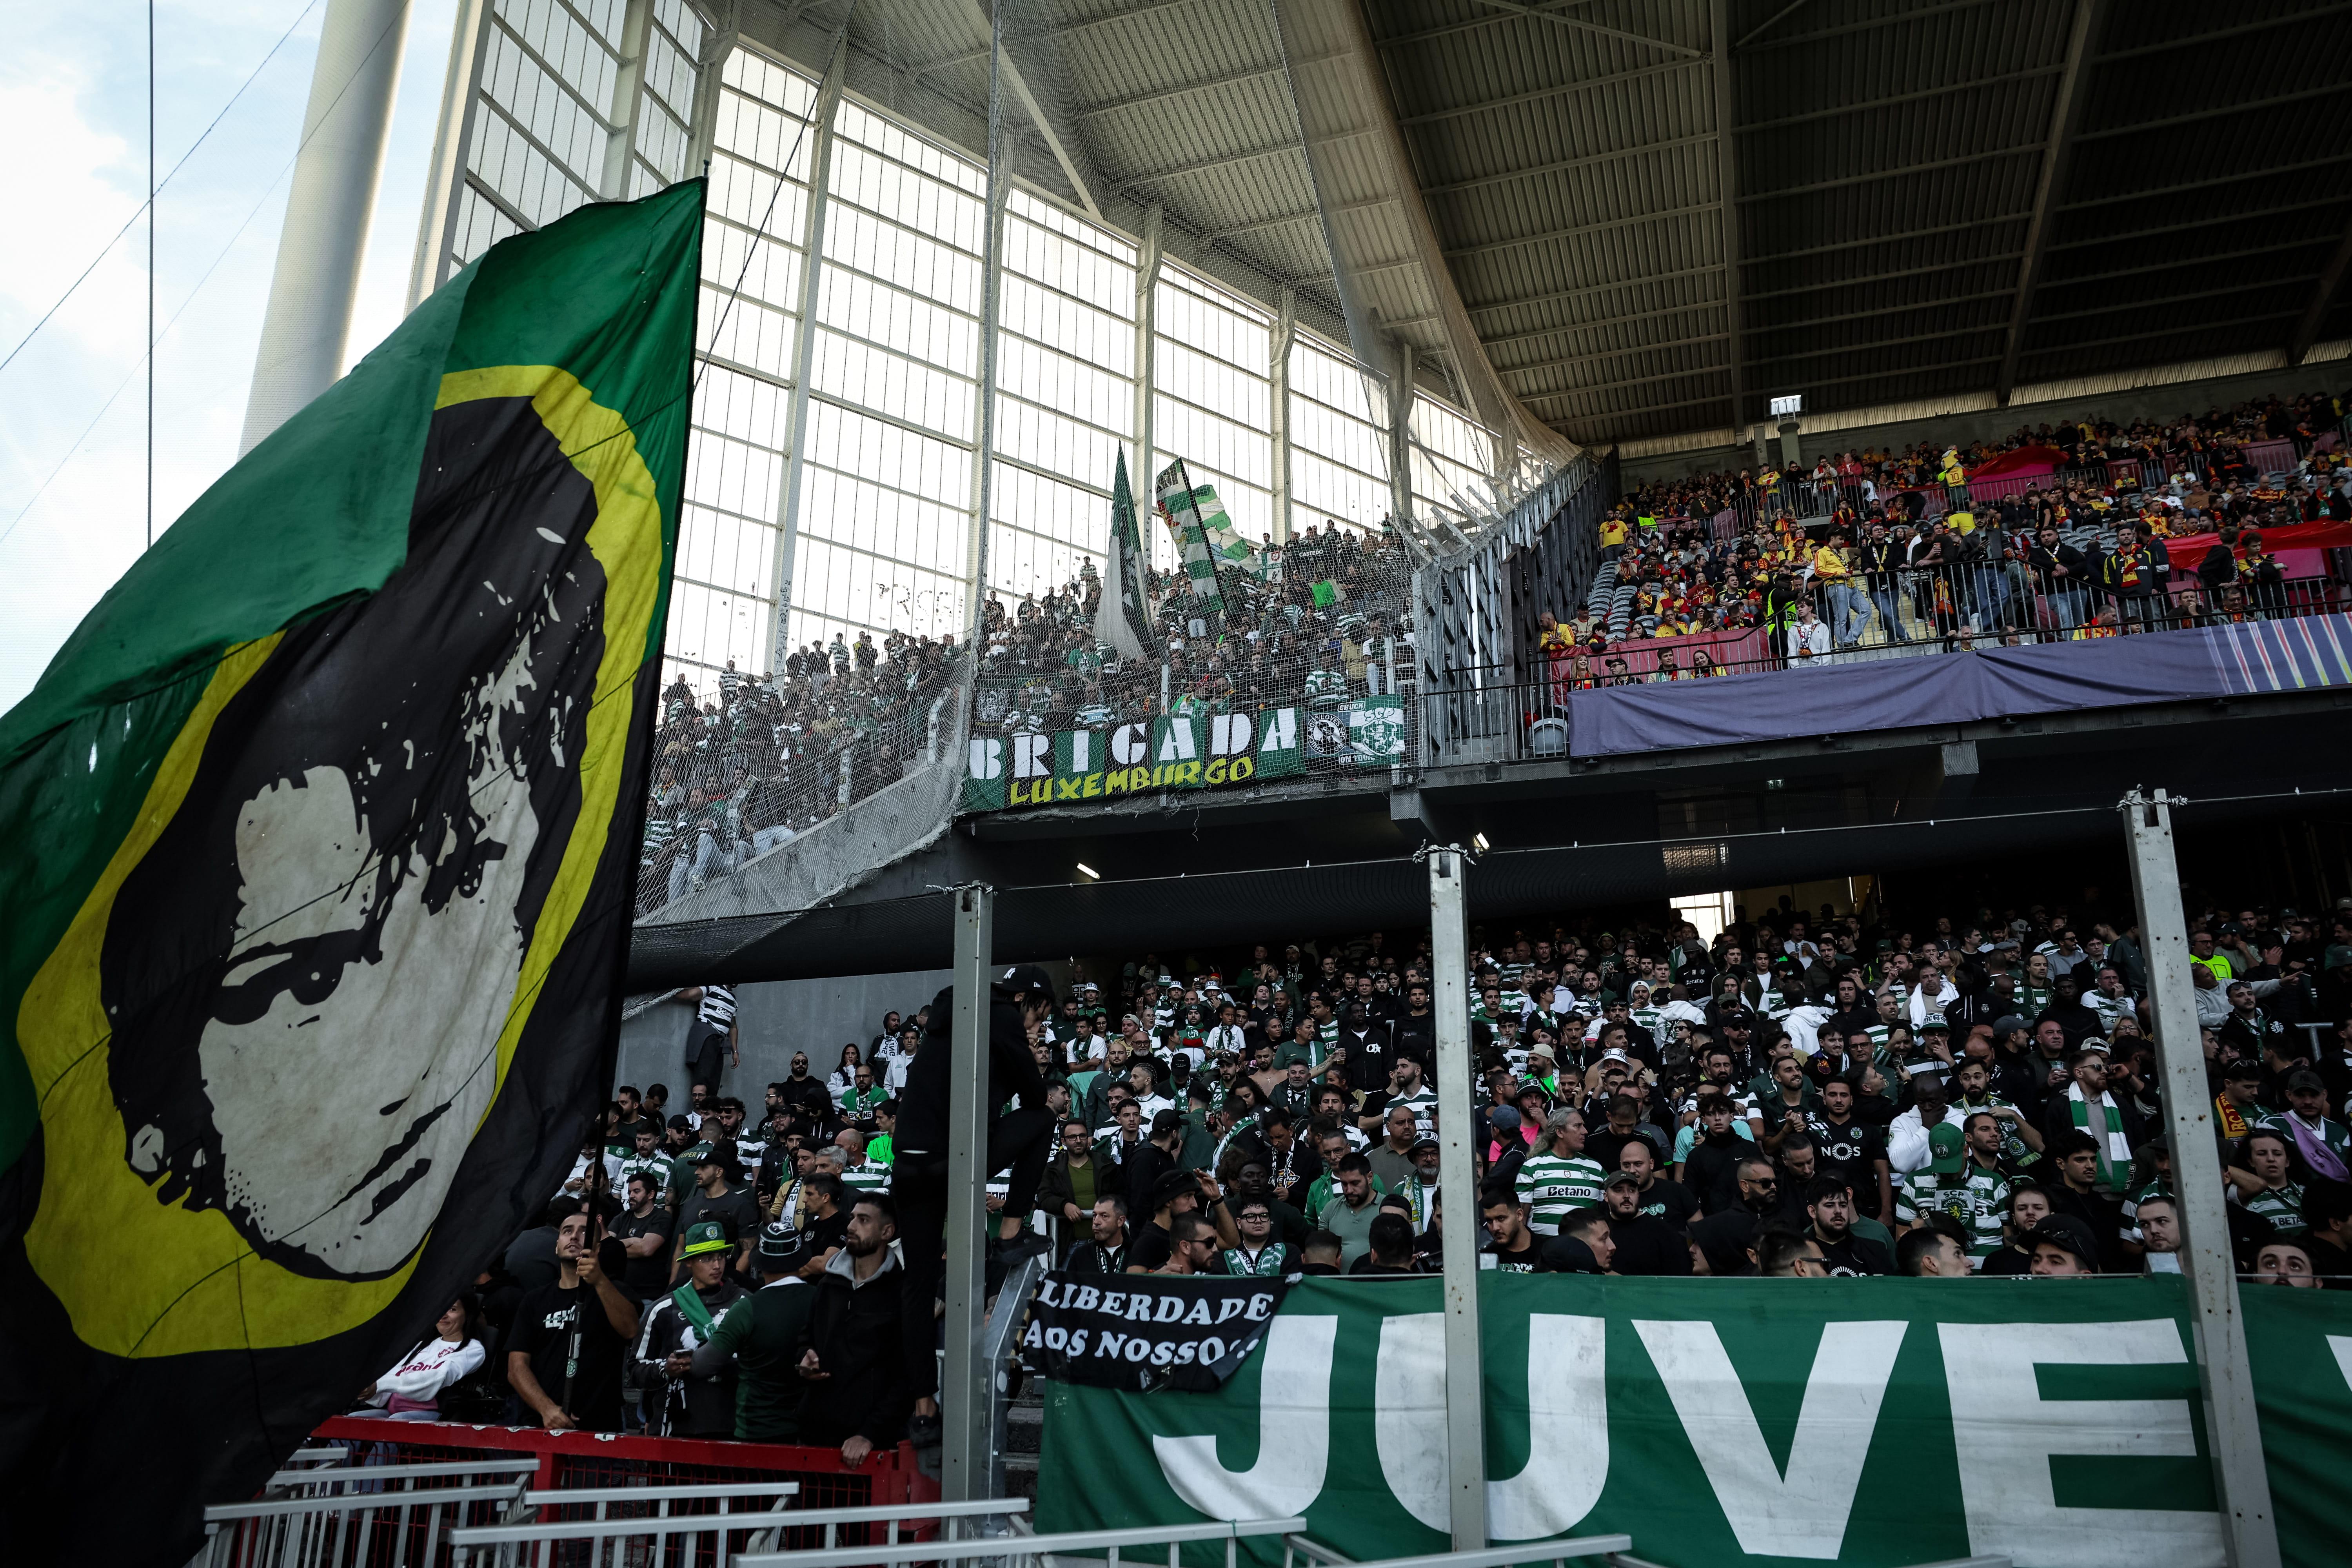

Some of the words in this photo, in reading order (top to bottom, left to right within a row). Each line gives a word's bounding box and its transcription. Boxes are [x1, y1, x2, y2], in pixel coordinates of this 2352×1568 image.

[1949, 472, 1958, 481] 10
[1320, 714, 1341, 727] LOVES
[1364, 707, 1395, 721] SCP
[970, 707, 1297, 779] BRIGADA
[1010, 756, 1253, 805] LUXEMBURGO
[1821, 1143, 1861, 1161] NOS
[1548, 1186, 1591, 1197] Betano
[1943, 1199, 1966, 1207] SPORTING
[2278, 1216, 2303, 1226] BETA
[1037, 1279, 1274, 1325] LIBERDADE
[1023, 1319, 1088, 1357] AOS
[1094, 1331, 1259, 1366] NOSSO
[1152, 1314, 2228, 1568] JUVE
